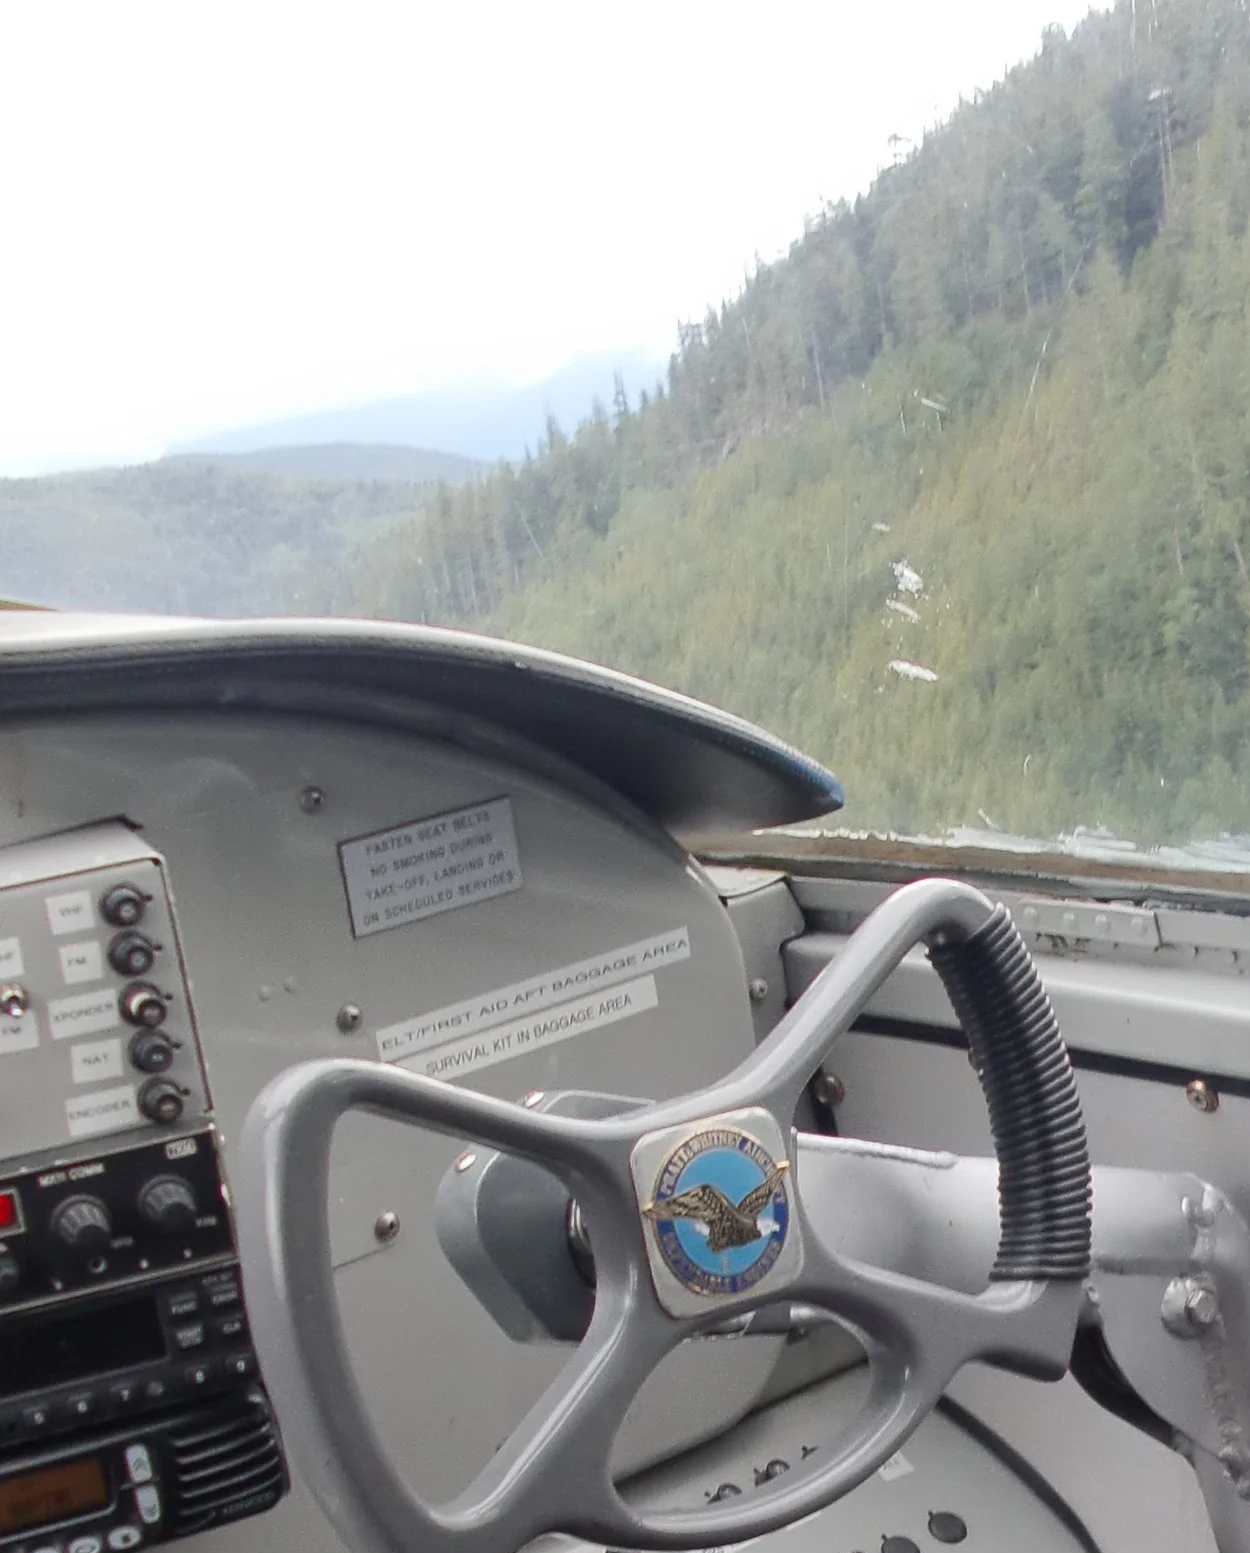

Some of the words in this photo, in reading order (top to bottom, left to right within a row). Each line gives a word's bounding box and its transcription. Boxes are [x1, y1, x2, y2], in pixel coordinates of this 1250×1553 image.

[366, 832, 413, 856] FASTEN
[417, 822, 446, 842] SEAT
[452, 810, 490, 832] BELTS
[370, 863, 388, 879] NO
[392, 845, 446, 872] SMOKING
[450, 832, 492, 855] DURING
[434, 857, 484, 882] LANDING
[488, 850, 504, 867] OR
[363, 911, 380, 927] ON
[384, 888, 453, 921] SCHEDULED
[458, 869, 514, 896] SERVICES
[382, 1010, 472, 1051] ELT/FIRST
[479, 999, 508, 1017] AID
[513, 983, 548, 1005] AFT
[552, 955, 637, 992] BAGGAGE
[642, 938, 688, 962] AREA
[425, 1043, 490, 1075] SURVIVAL
[493, 1034, 512, 1053] KIT
[517, 1028, 531, 1044] IN
[533, 1006, 596, 1039] BAGGAGE
[598, 993, 633, 1017] AREA
[69, 1099, 131, 1121] ENCODER
[687, 1130, 741, 1155] WHITNEY
